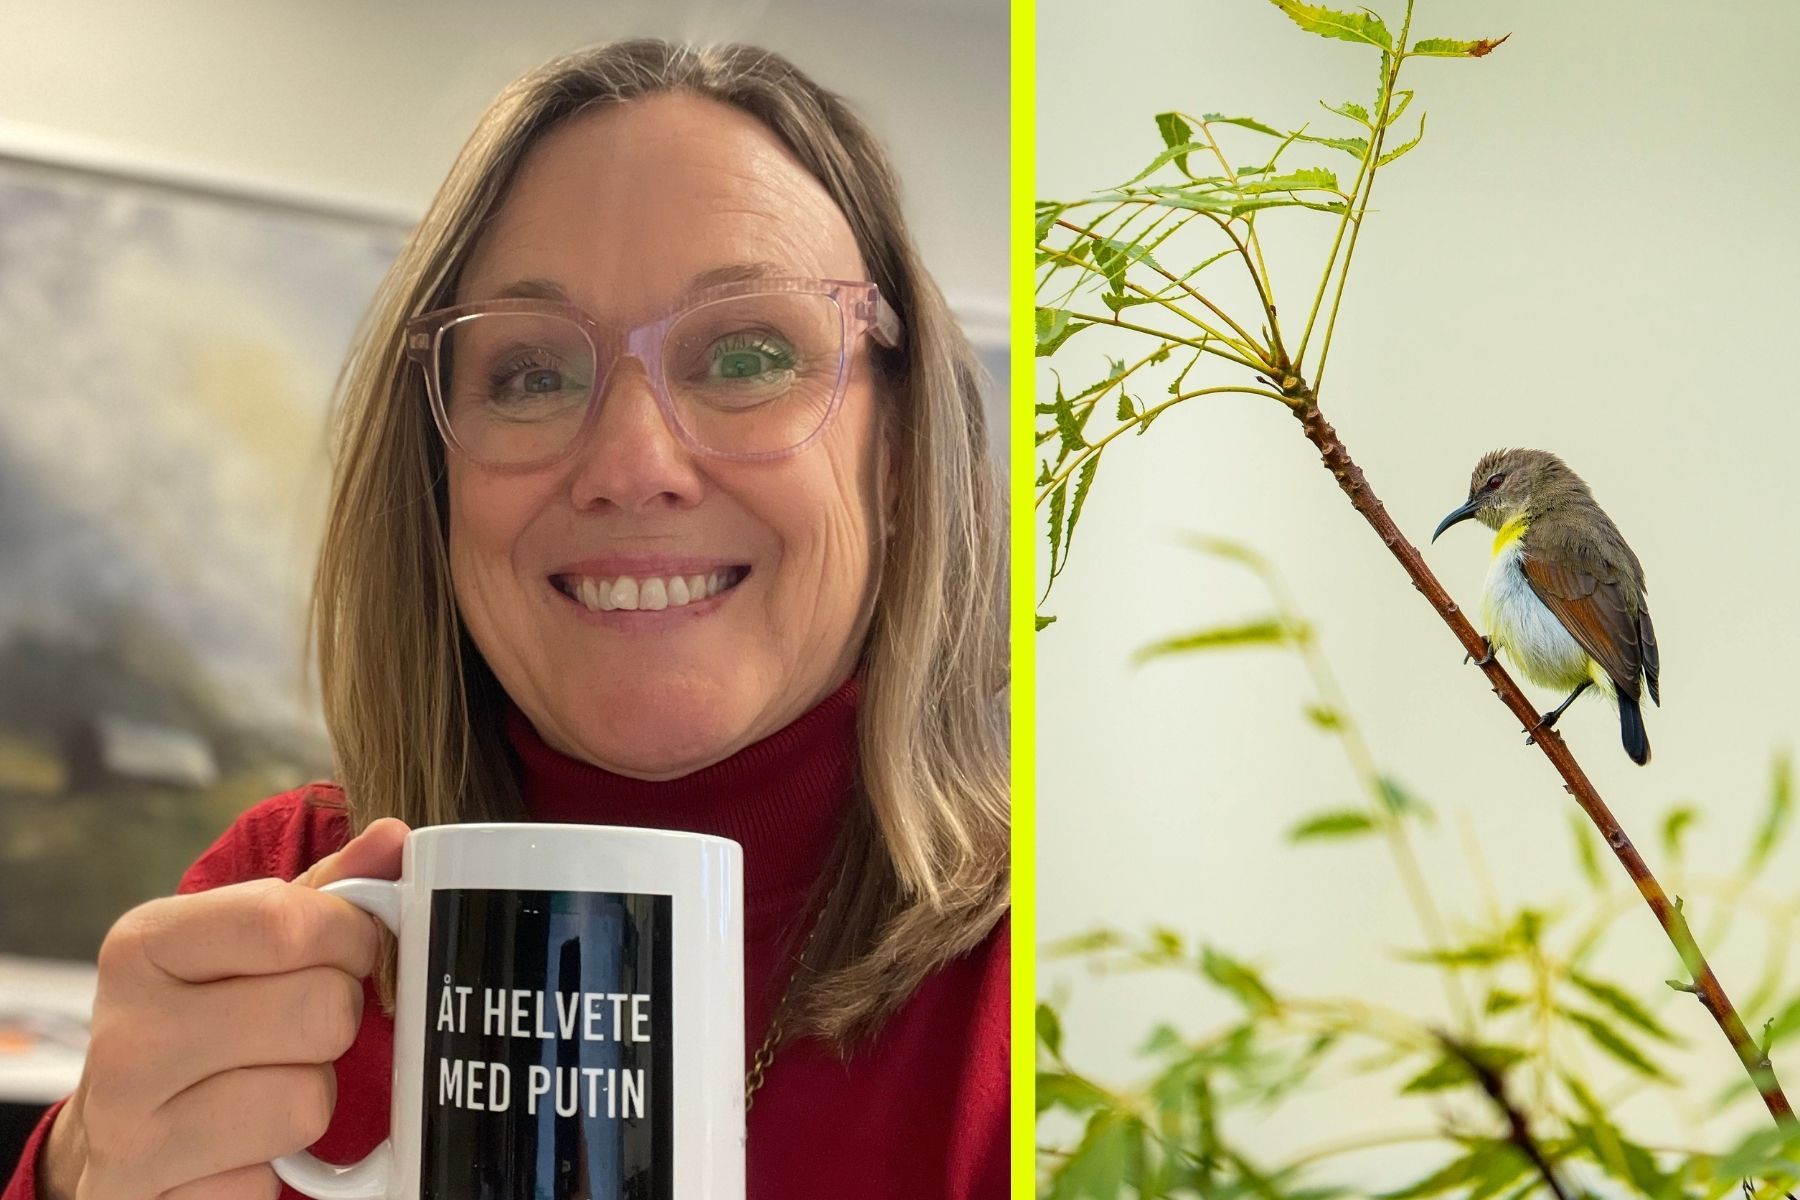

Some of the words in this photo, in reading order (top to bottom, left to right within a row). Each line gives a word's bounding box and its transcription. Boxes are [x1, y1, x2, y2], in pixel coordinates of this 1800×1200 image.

[437, 974, 473, 1033] ÅT
[484, 988, 651, 1042] HELVETE
[439, 1057, 511, 1112] MED
[528, 1065, 645, 1119] PUTIN
